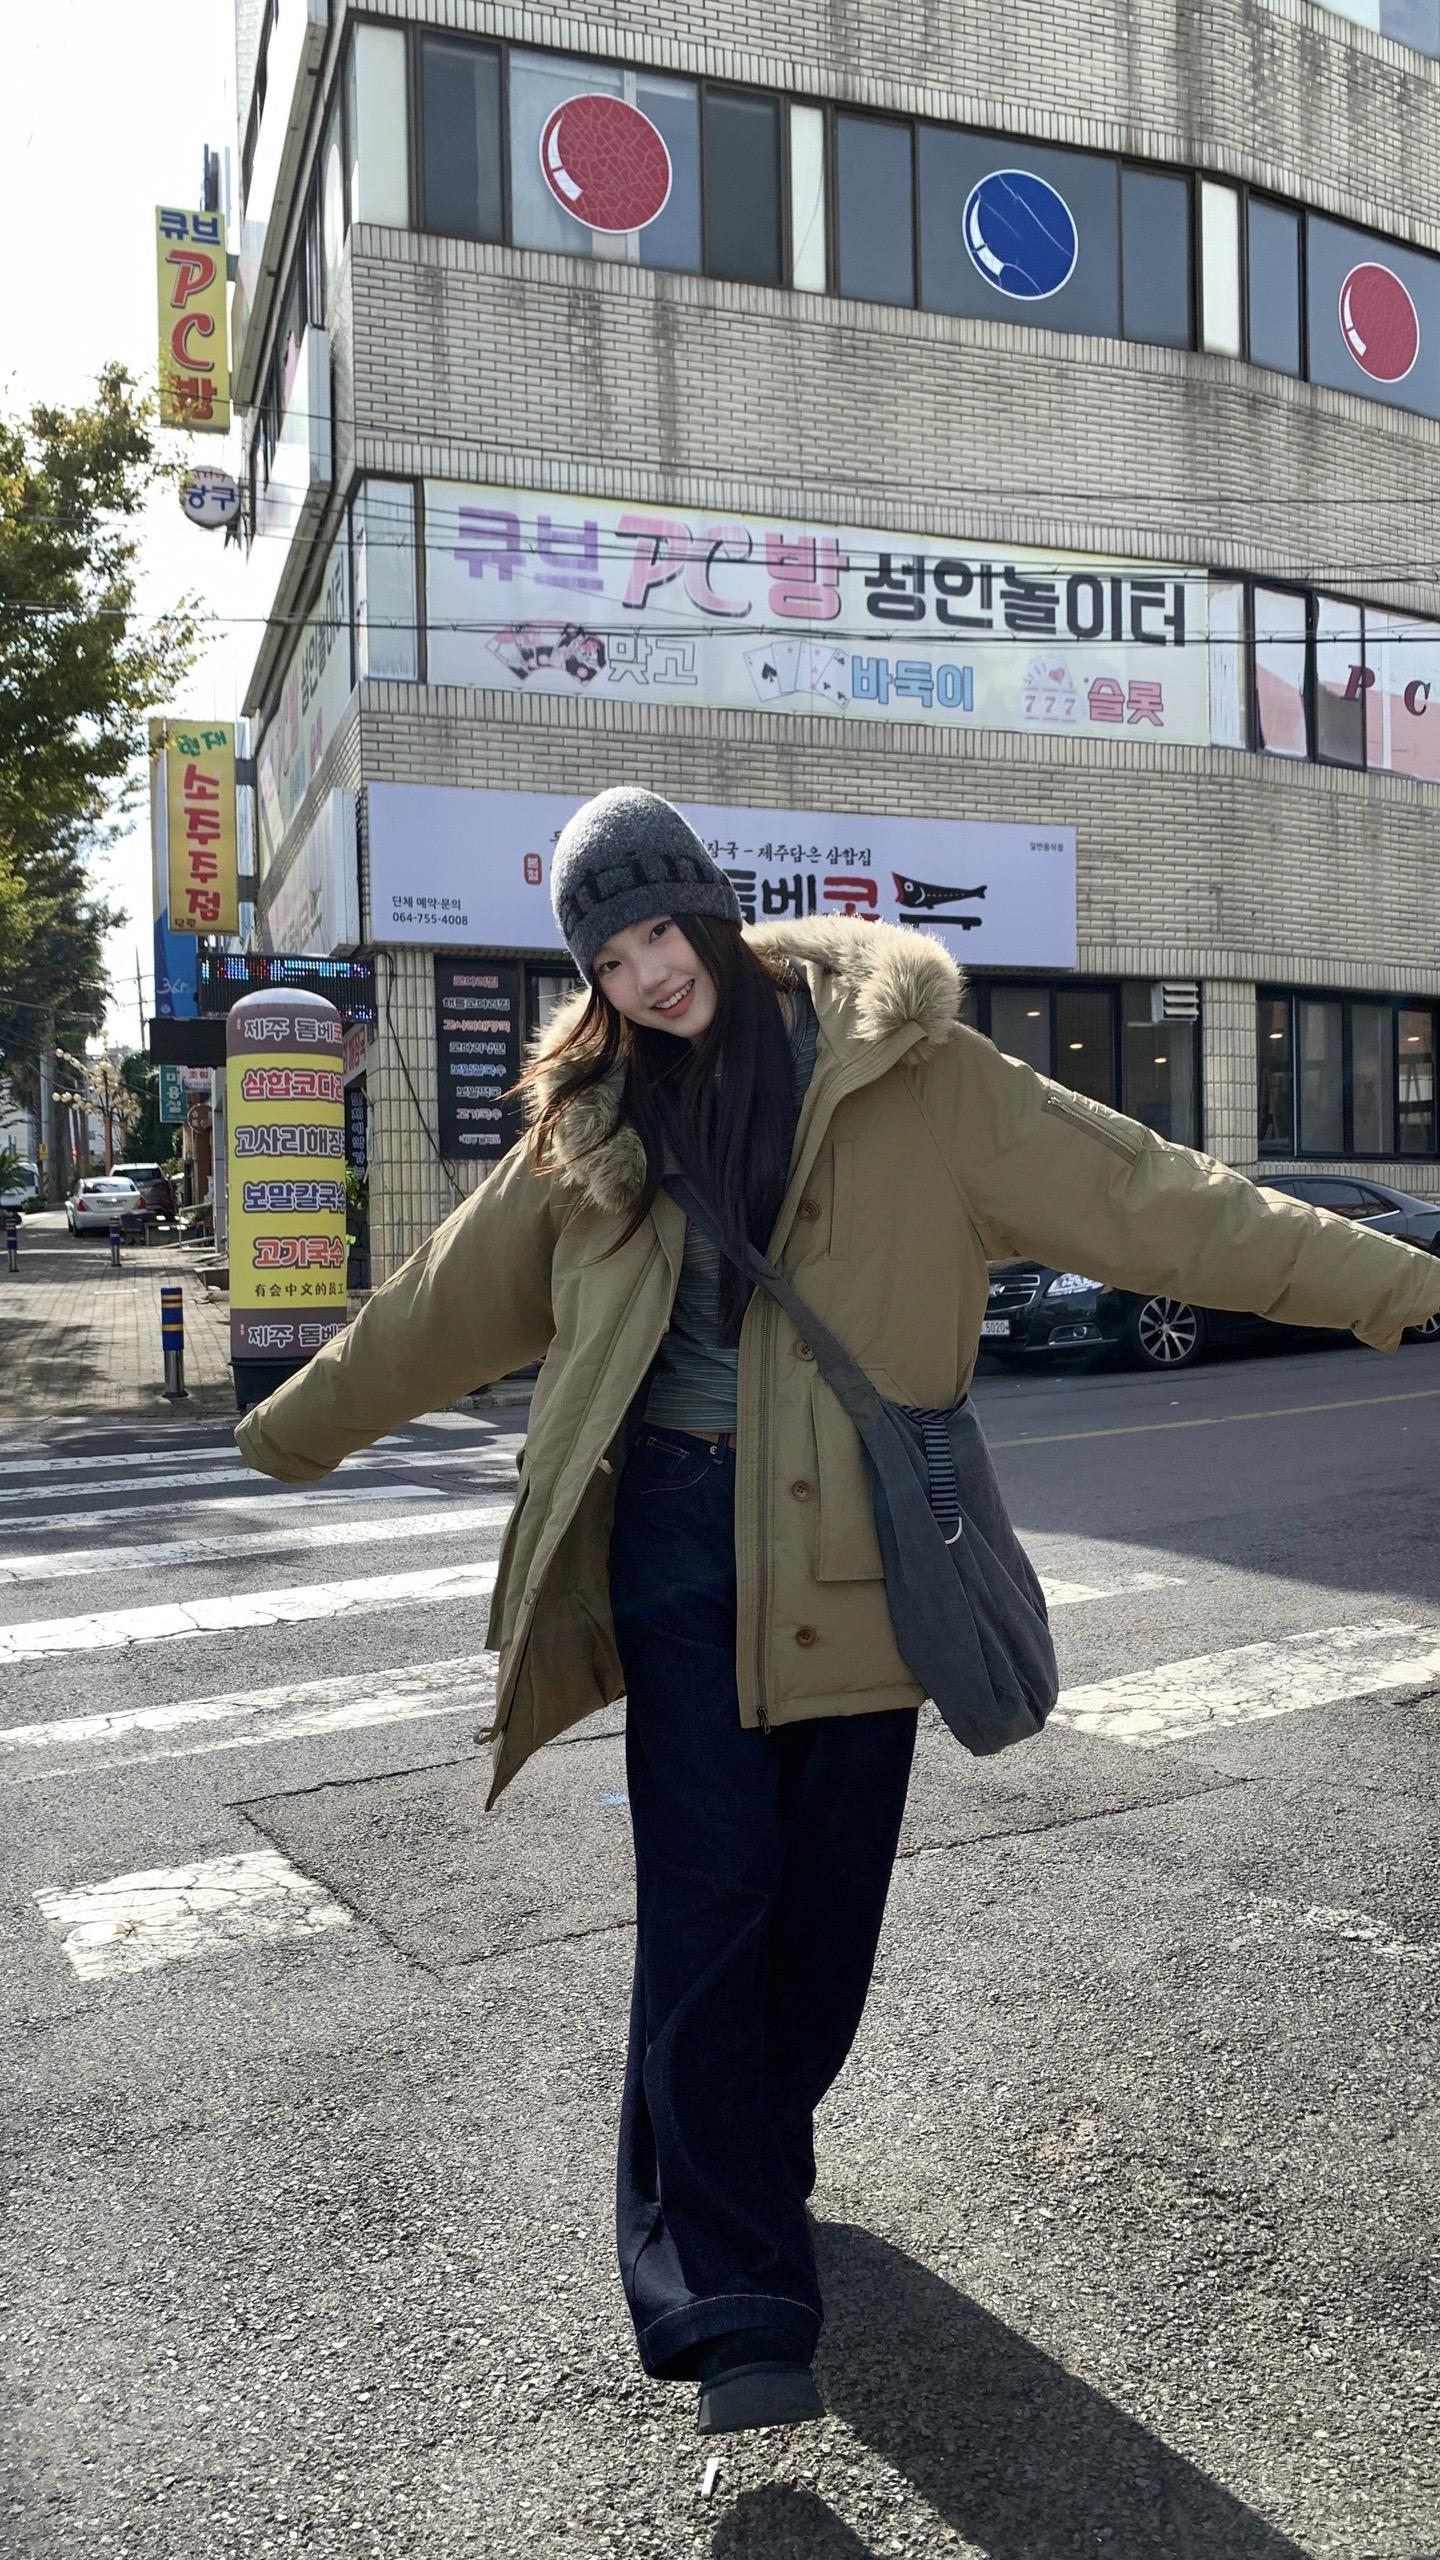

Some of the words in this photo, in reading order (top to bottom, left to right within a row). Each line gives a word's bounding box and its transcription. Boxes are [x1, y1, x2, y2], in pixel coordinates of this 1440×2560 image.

[160, 210, 220, 245] 큐브
[454, 506, 604, 591] 큐브
[615, 514, 849, 620] PC방
[865, 552, 1185, 647] 성인놀이터
[608, 635, 698, 686] 맞고
[851, 655, 974, 712] 바둑이
[1088, 677, 1164, 727] 슬롯
[183, 763, 221, 922] 소주주점
[703, 838, 739, 860] 장국
[825, 846, 871, 867] 삼합집
[392, 896, 413, 908] 단체
[392, 911, 468, 926] 064-755-4008
[245, 1017, 290, 1041] 제주
[236, 1125, 345, 1157] 고사리해장
[254, 1236, 345, 1268] 고기국수
[255, 1282, 344, 1297] 有会中文的员工
[248, 1324, 294, 1348] 제주
[298, 1323, 346, 1347] 돔베
